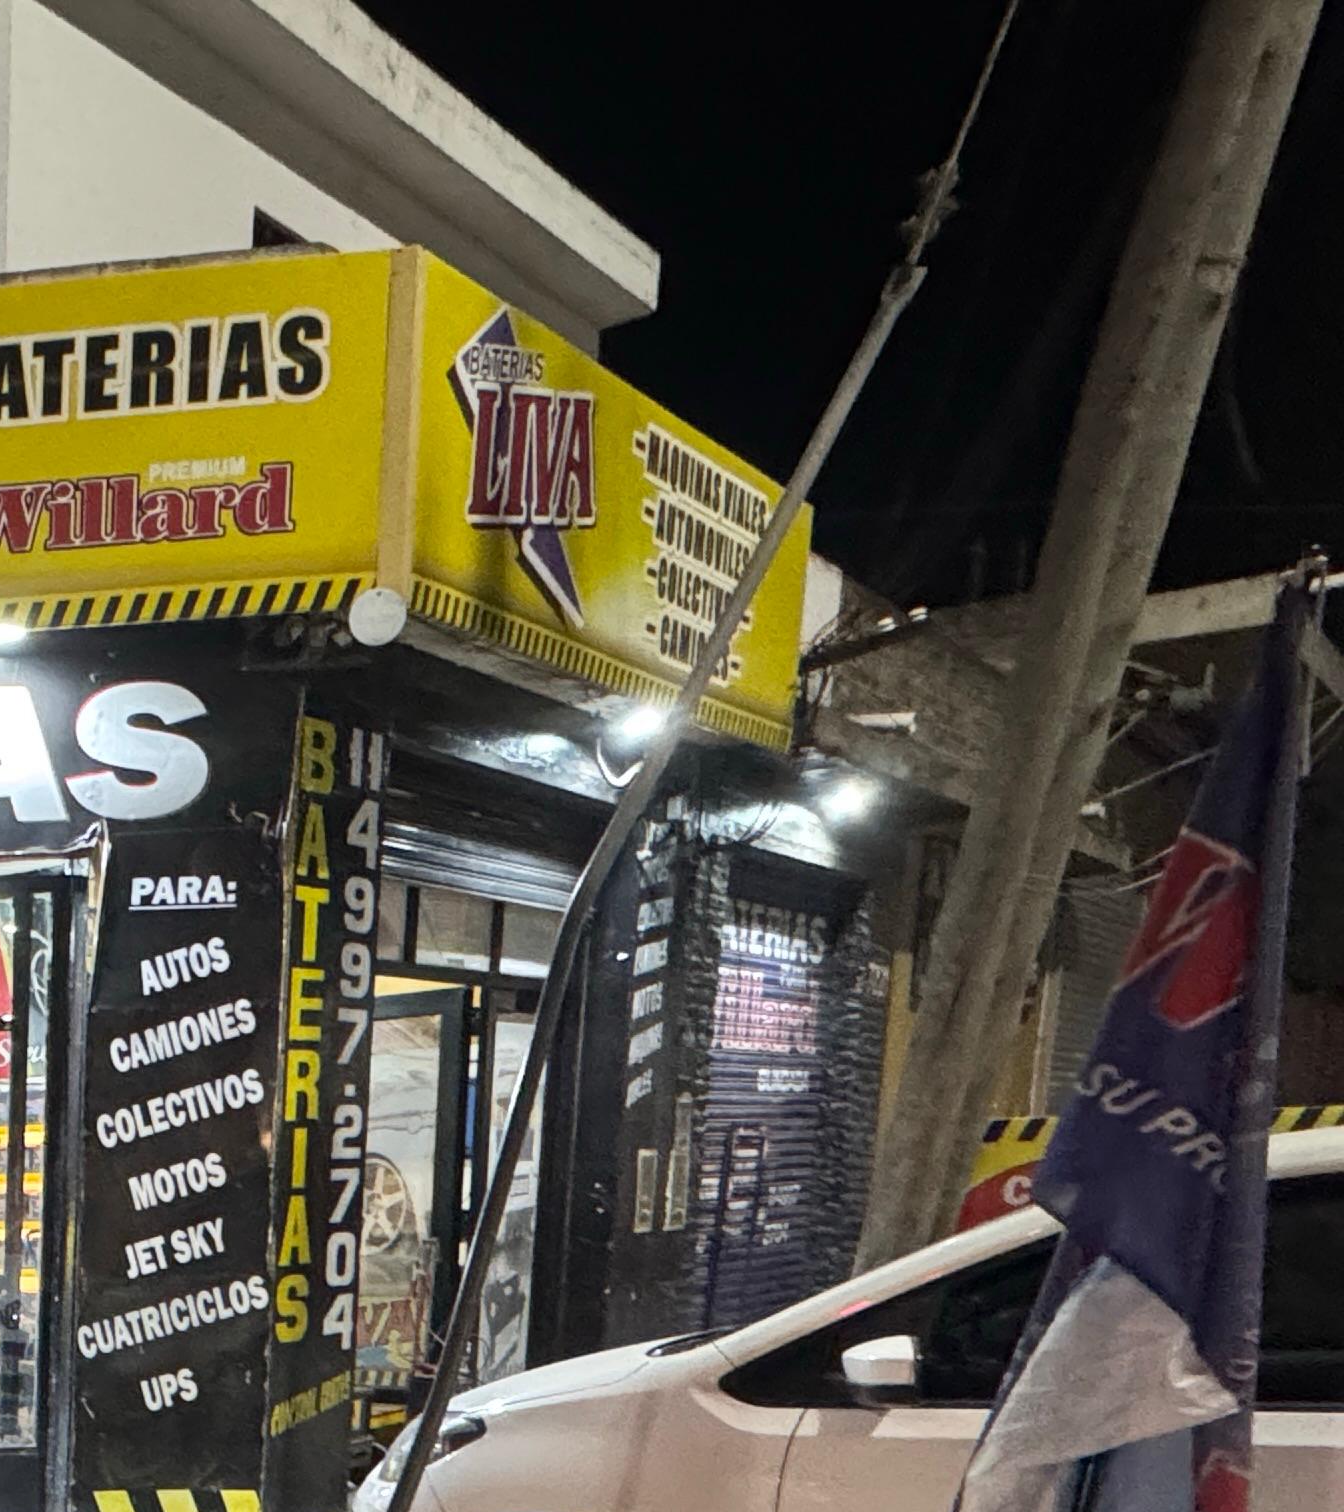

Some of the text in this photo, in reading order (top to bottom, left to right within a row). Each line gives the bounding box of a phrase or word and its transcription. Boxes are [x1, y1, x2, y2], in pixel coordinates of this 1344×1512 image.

[467, 344, 544, 382] BATERIAS
[148, 456, 246, 482] PREMIUM
[466, 385, 596, 524] LIVA
[129, 875, 237, 906] PARA:
[139, 936, 231, 996] AUTOS
[109, 998, 257, 1074] CAMIONES
[274, 715, 337, 1344] BATERIAS
[96, 1067, 265, 1150] COLECTIVOS
[128, 1152, 227, 1212] MOTOS
[124, 1217, 226, 1280] JET SKY
[77, 1274, 270, 1360] CUATRICICLOS
[139, 1367, 199, 1413] UPS
